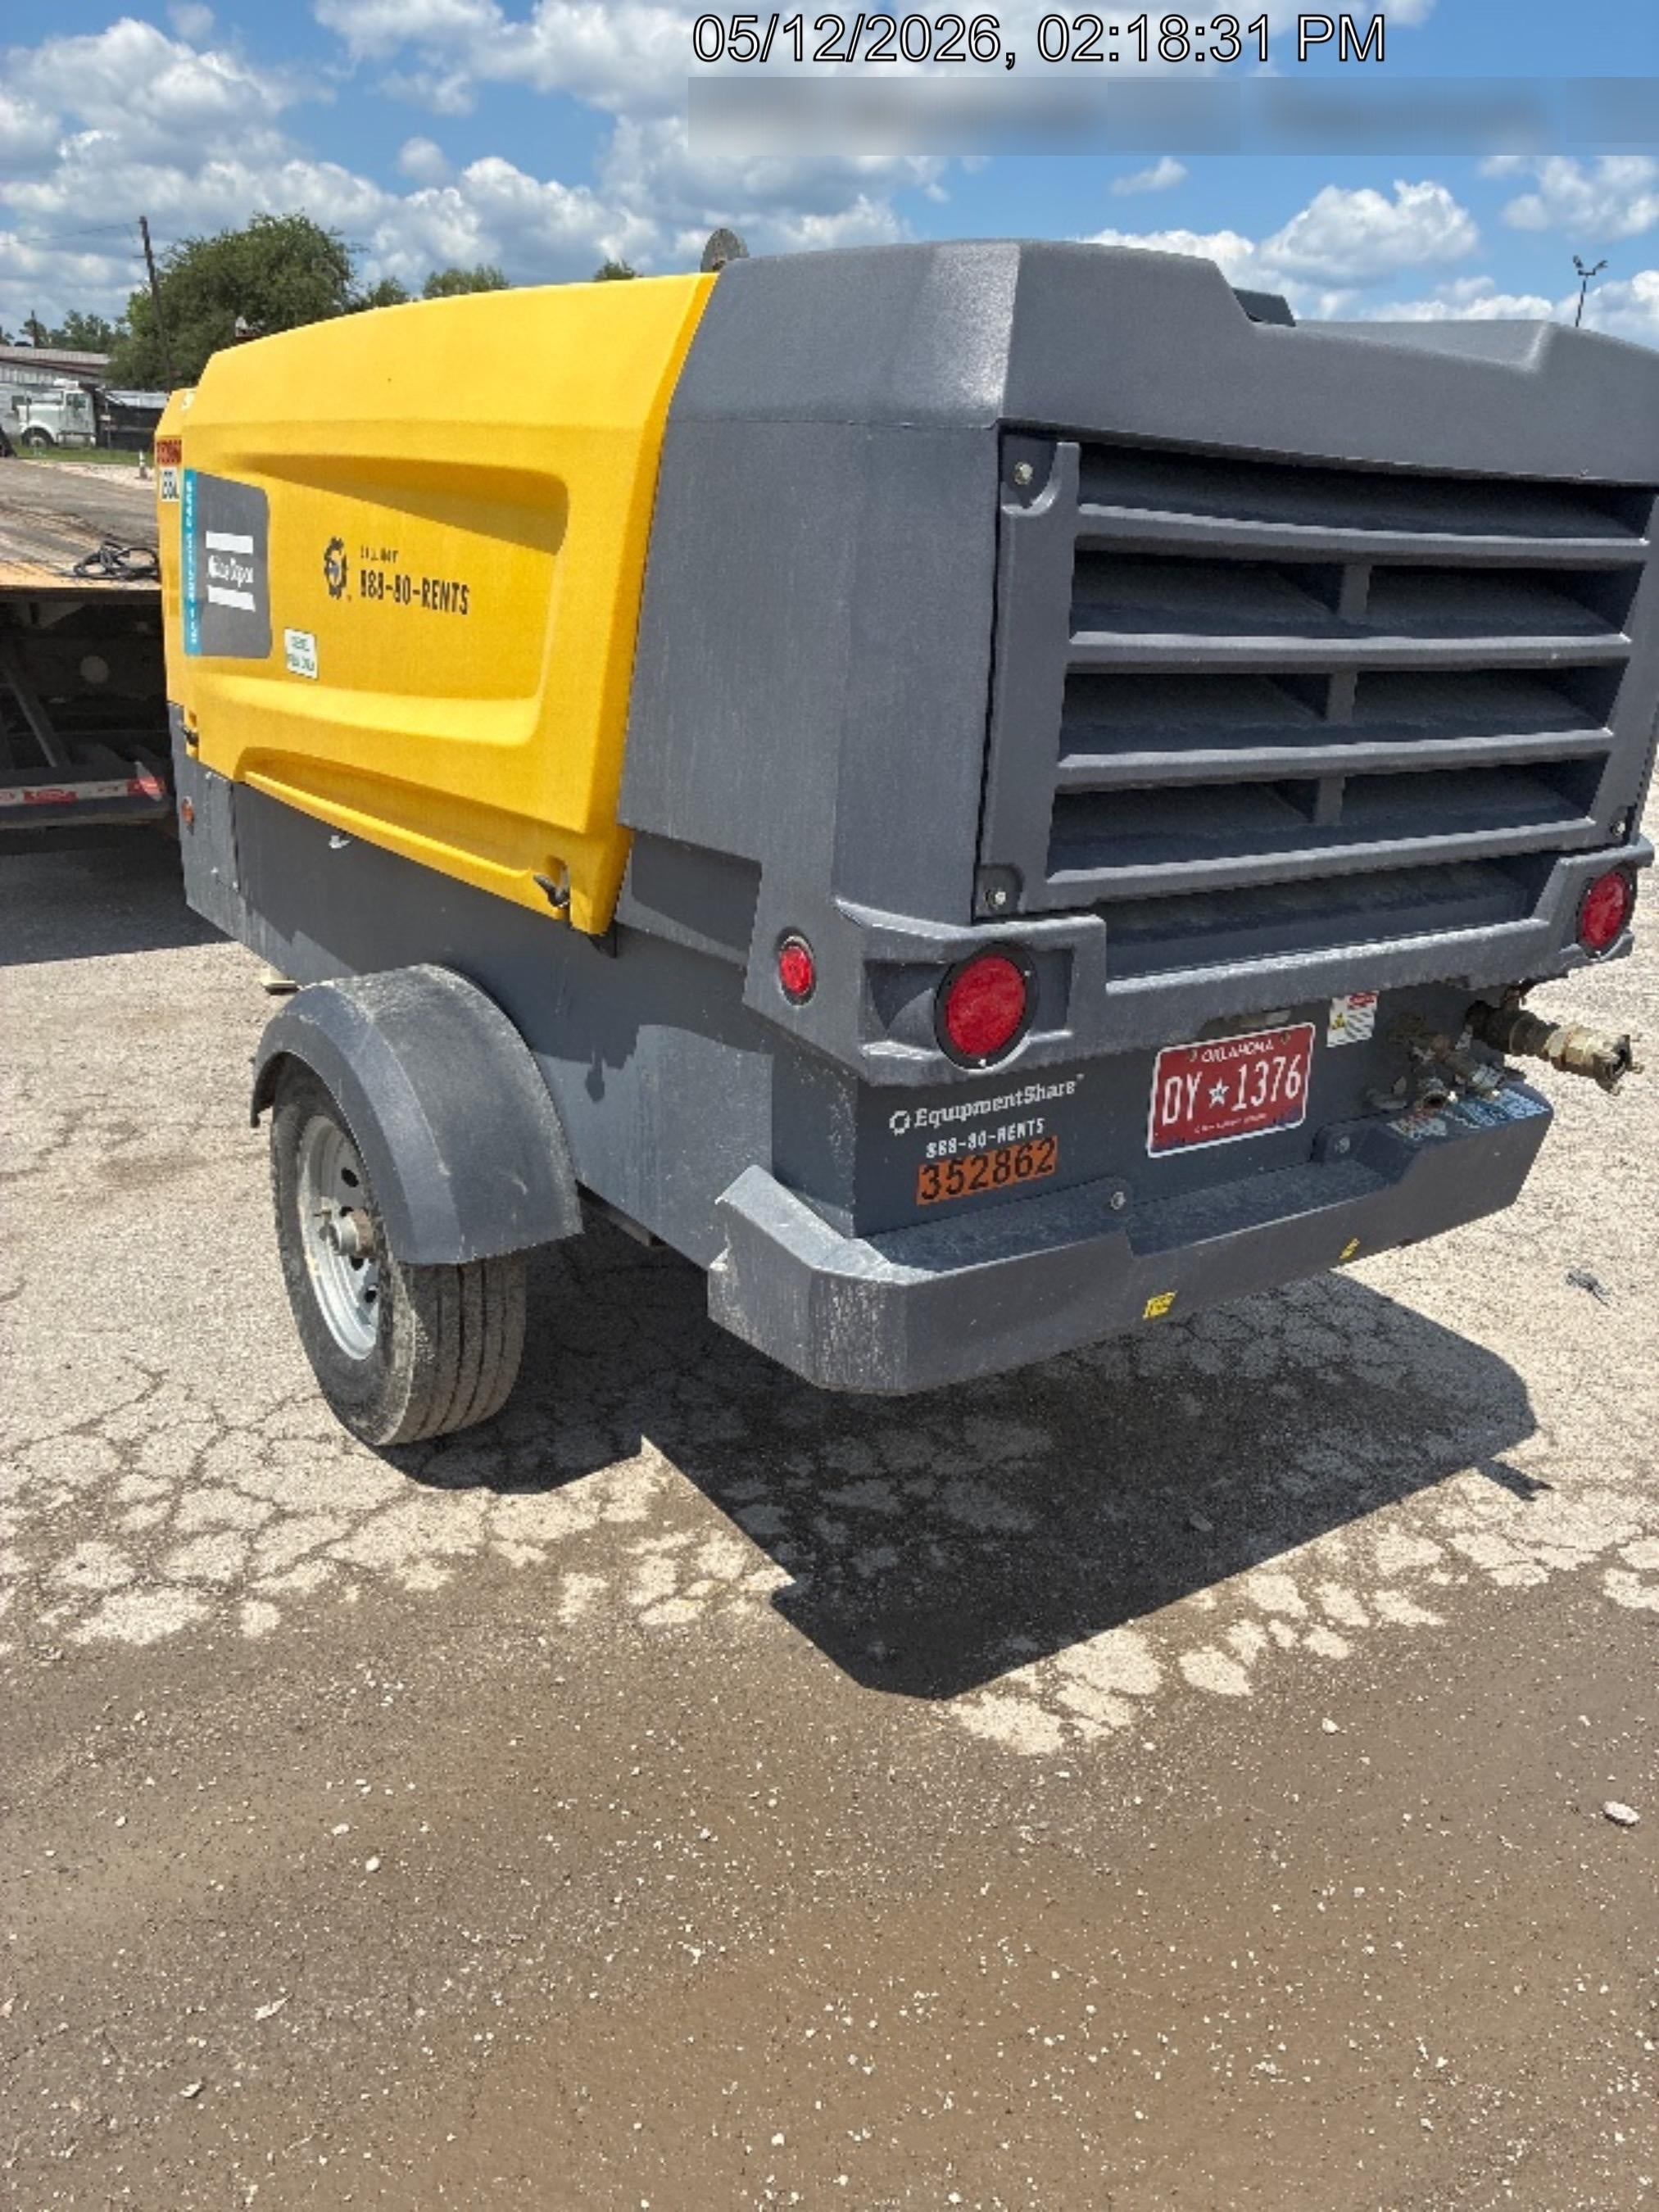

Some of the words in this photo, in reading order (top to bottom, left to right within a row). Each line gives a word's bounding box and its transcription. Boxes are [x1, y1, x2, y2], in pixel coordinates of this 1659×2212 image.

[913, 1080, 1077, 1129] EquipmentShare
[1162, 1071, 1203, 1126] DY
[1231, 1054, 1302, 1111] 1376
[920, 1137, 1057, 1201] 352862
